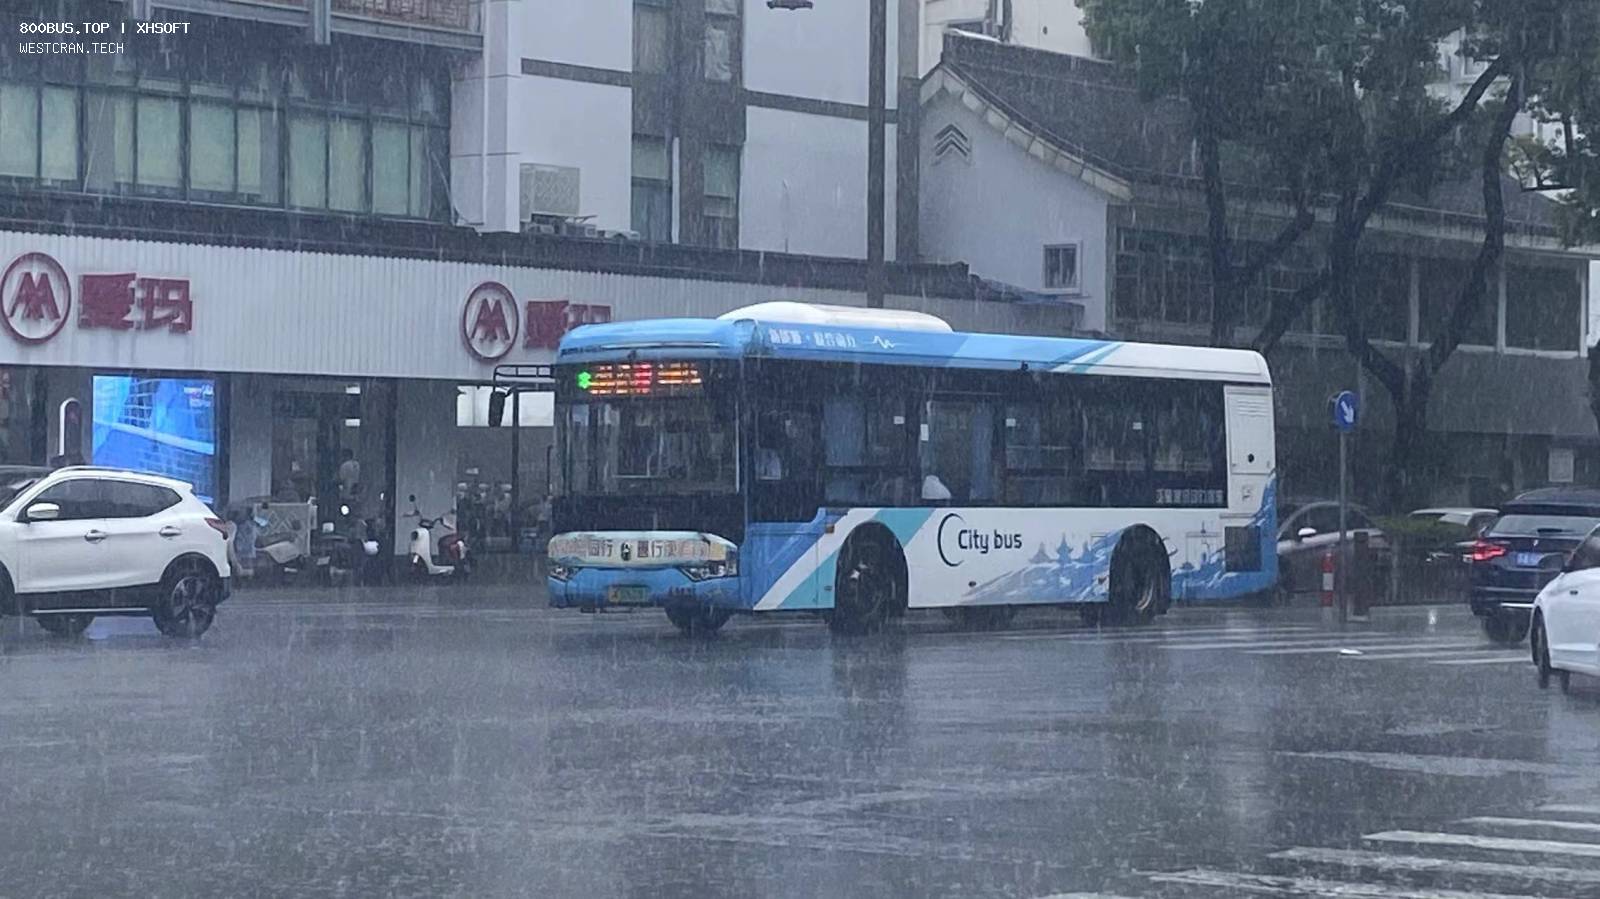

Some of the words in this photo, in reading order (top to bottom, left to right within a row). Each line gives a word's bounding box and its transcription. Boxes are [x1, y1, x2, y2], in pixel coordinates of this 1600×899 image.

[78, 272, 193, 334] 爱玛
[958, 529, 989, 554] City
[993, 529, 1023, 549] bus
